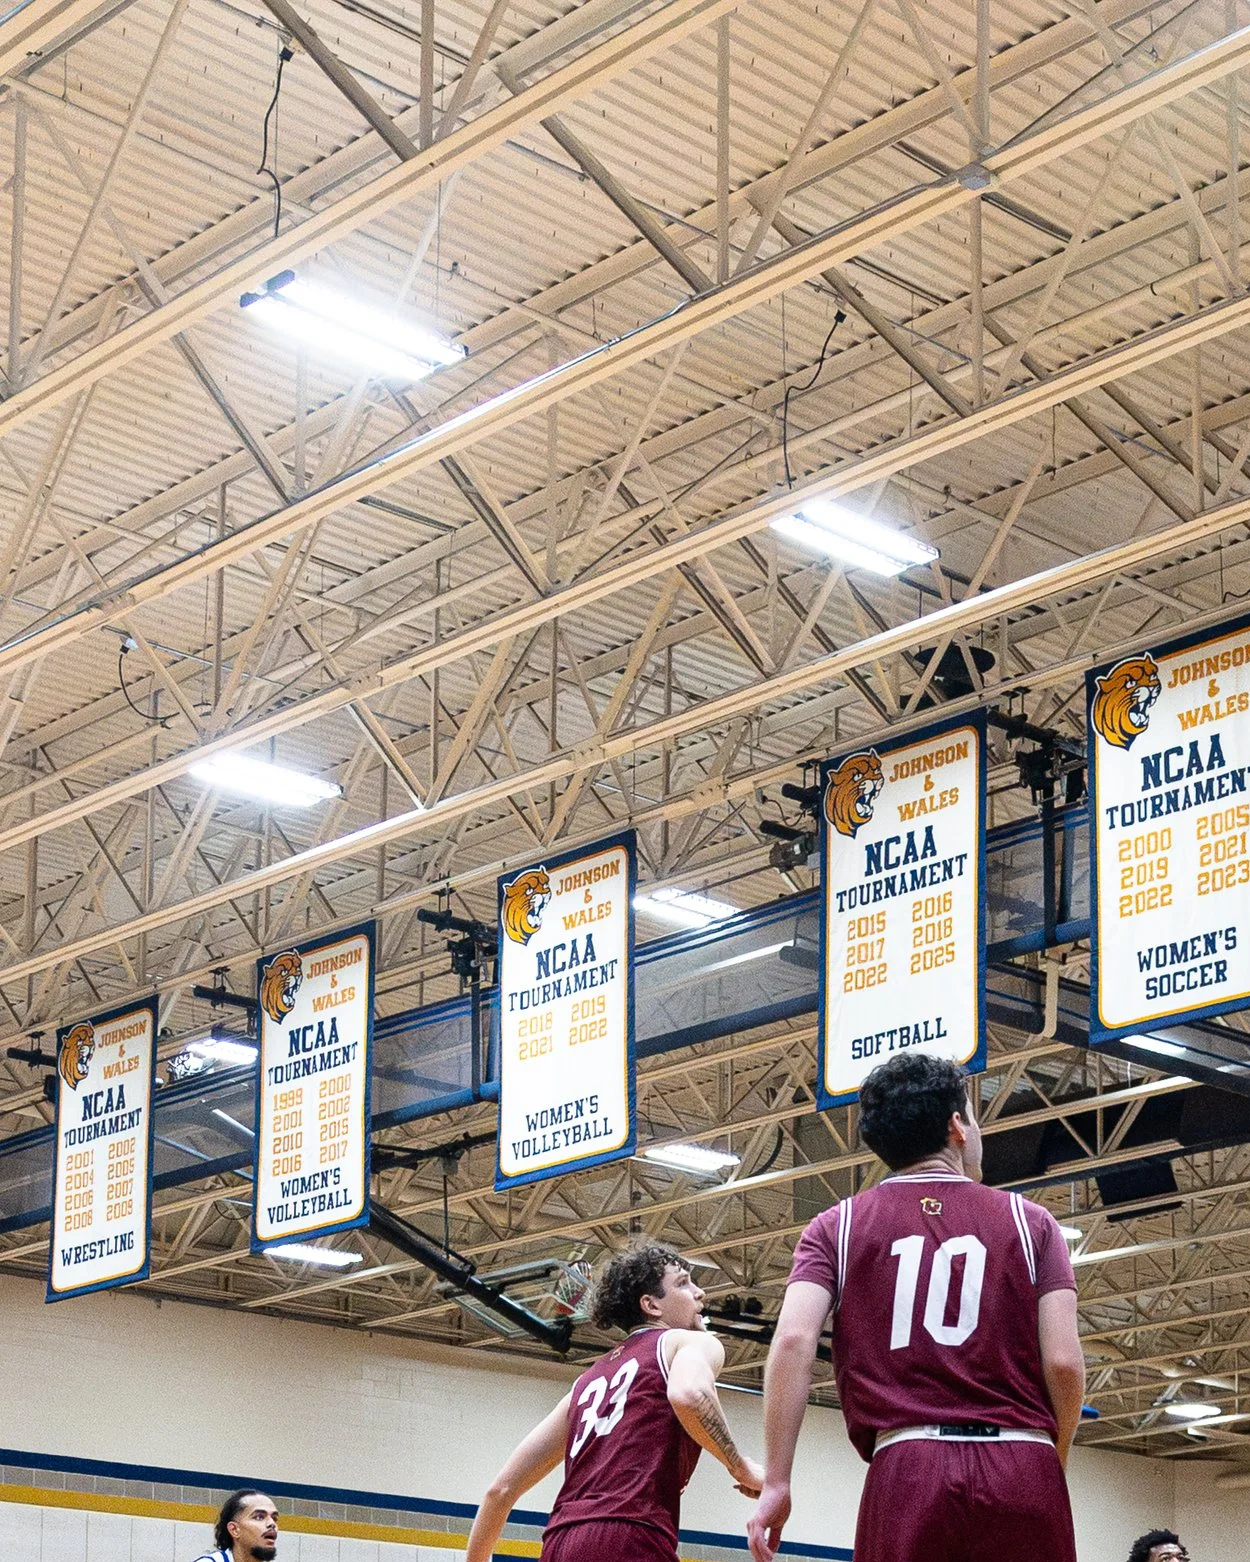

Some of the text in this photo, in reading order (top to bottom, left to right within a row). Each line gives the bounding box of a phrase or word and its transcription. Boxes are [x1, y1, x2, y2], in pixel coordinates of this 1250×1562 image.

[1207, 678, 1220, 698] &
[1177, 691, 1250, 731] WALES
[889, 741, 969, 782] JOHNSON
[1141, 733, 1226, 792] NCAA
[923, 774, 935, 792] &
[897, 787, 960, 822] WALES
[864, 825, 938, 877] NCAA
[1118, 804, 1250, 862] 2000 2005
[556, 859, 620, 896] JOHNSON
[1121, 832, 1247, 890] 2019 2021
[583, 888, 593, 905] &
[836, 853, 968, 912] TOURNAMENT
[1119, 859, 1250, 918] 2022 2023
[562, 901, 612, 931] WALES
[847, 891, 953, 942] 2015 2016
[536, 933, 596, 981] NCAA
[846, 917, 953, 968] 2017 2018
[1137, 926, 1237, 973] WOMEN'S
[306, 947, 362, 980] JOHNSON
[843, 941, 956, 994] 2022 2025
[1145, 959, 1228, 1000] SOCCER
[312, 986, 356, 1013] WALES
[508, 958, 618, 1012] TOURNAMENT
[98, 1019, 147, 1048] JOHNSON
[518, 994, 606, 1038] 2018 2019
[288, 1017, 340, 1058] NCAA
[518, 1017, 608, 1061] 2021 2022
[852, 1017, 948, 1060] SOFTBALL
[103, 1055, 139, 1080] WALES
[268, 1041, 358, 1086] TOURNAMENT
[81, 1084, 126, 1122] NCAA
[273, 1073, 352, 1112] 1999 2000
[64, 1107, 142, 1148] TOURNAMENT
[272, 1095, 351, 1133] 2001 2002
[526, 1094, 599, 1132] WOMEN'S
[66, 1137, 136, 1171] 2001 2002
[272, 1117, 349, 1155] 2010 2015
[512, 1116, 613, 1160] VOLLEYBALL
[65, 1158, 135, 1191] 2004 2005
[272, 1139, 348, 1177] 2016 2017
[106, 1178, 134, 1201] 2007
[280, 1166, 341, 1199] WOMEN'S
[267, 1188, 353, 1224] VOLLEYBALL
[61, 1231, 134, 1267] WRESTLING
[889, 1234, 988, 1350] 10
[569, 1357, 640, 1459] 33
